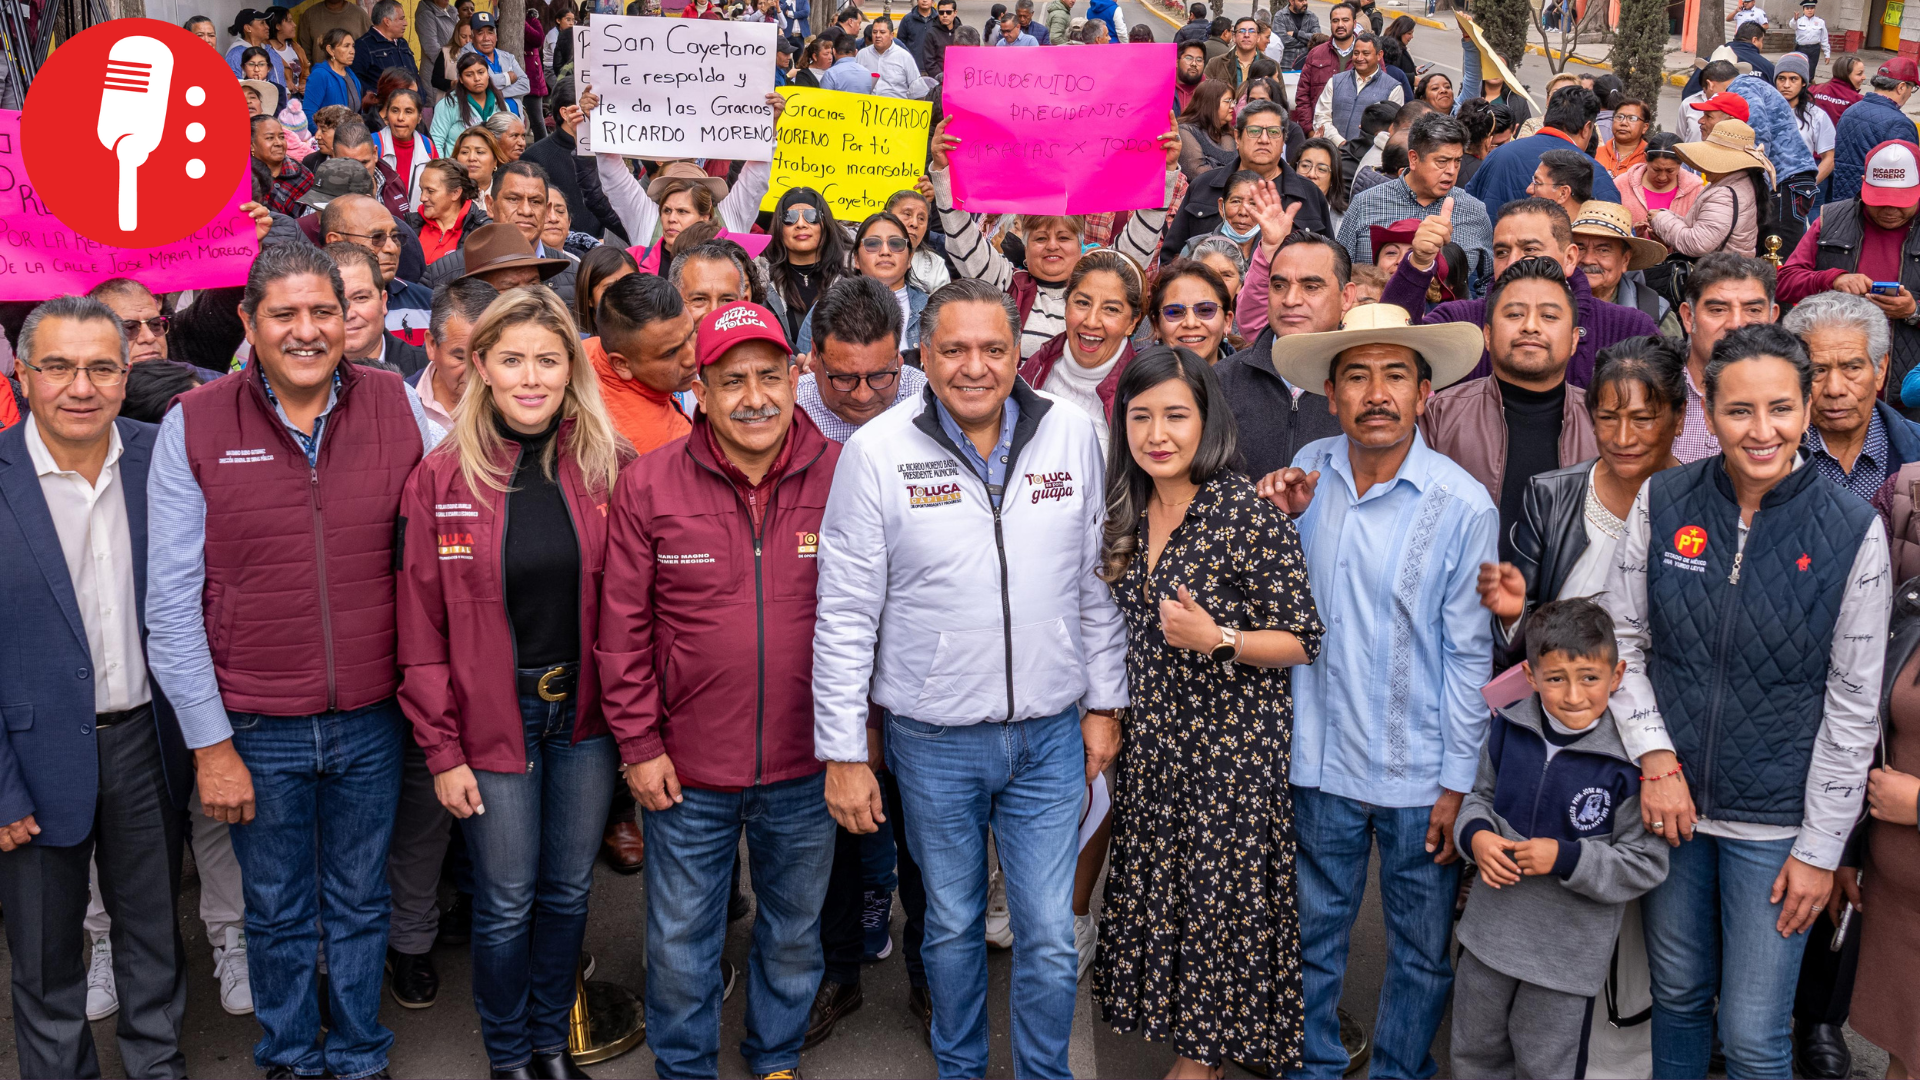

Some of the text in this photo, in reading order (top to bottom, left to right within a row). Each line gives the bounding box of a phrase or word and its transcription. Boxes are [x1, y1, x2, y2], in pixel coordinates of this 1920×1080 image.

[603, 24, 654, 52] San
[602, 64, 632, 85] Te
[643, 66, 725, 88] respalda
[734, 72, 747, 88] y
[598, 94, 772, 116] te da las Gracias
[784, 93, 930, 130] Gracias RICARDO
[602, 121, 685, 144] RICARDO
[700, 124, 772, 144] MORENO
[842, 133, 864, 152] Por
[870, 135, 890, 155] tú
[968, 140, 1060, 164] GRACIAS
[1100, 137, 1152, 158] TODO
[773, 152, 920, 178] trabajo incansable
[822, 183, 886, 210] Cayetan
[42, 232, 68, 250] LA
[25, 261, 46, 275] LA
[198, 244, 254, 260] MORELOS
[723, 318, 768, 332] TOLUCA
[903, 470, 934, 480] PRESIDENTE
[906, 462, 925, 472] RICARDO
[924, 460, 944, 470] MORENO
[1024, 472, 1072, 486] TOLUCA
[906, 482, 962, 498] TOLUCA
[911, 492, 960, 504] CAPITAL
[1031, 486, 1074, 504] guapa
[438, 532, 475, 546] LUCA
[1678, 534, 1704, 554] PT
